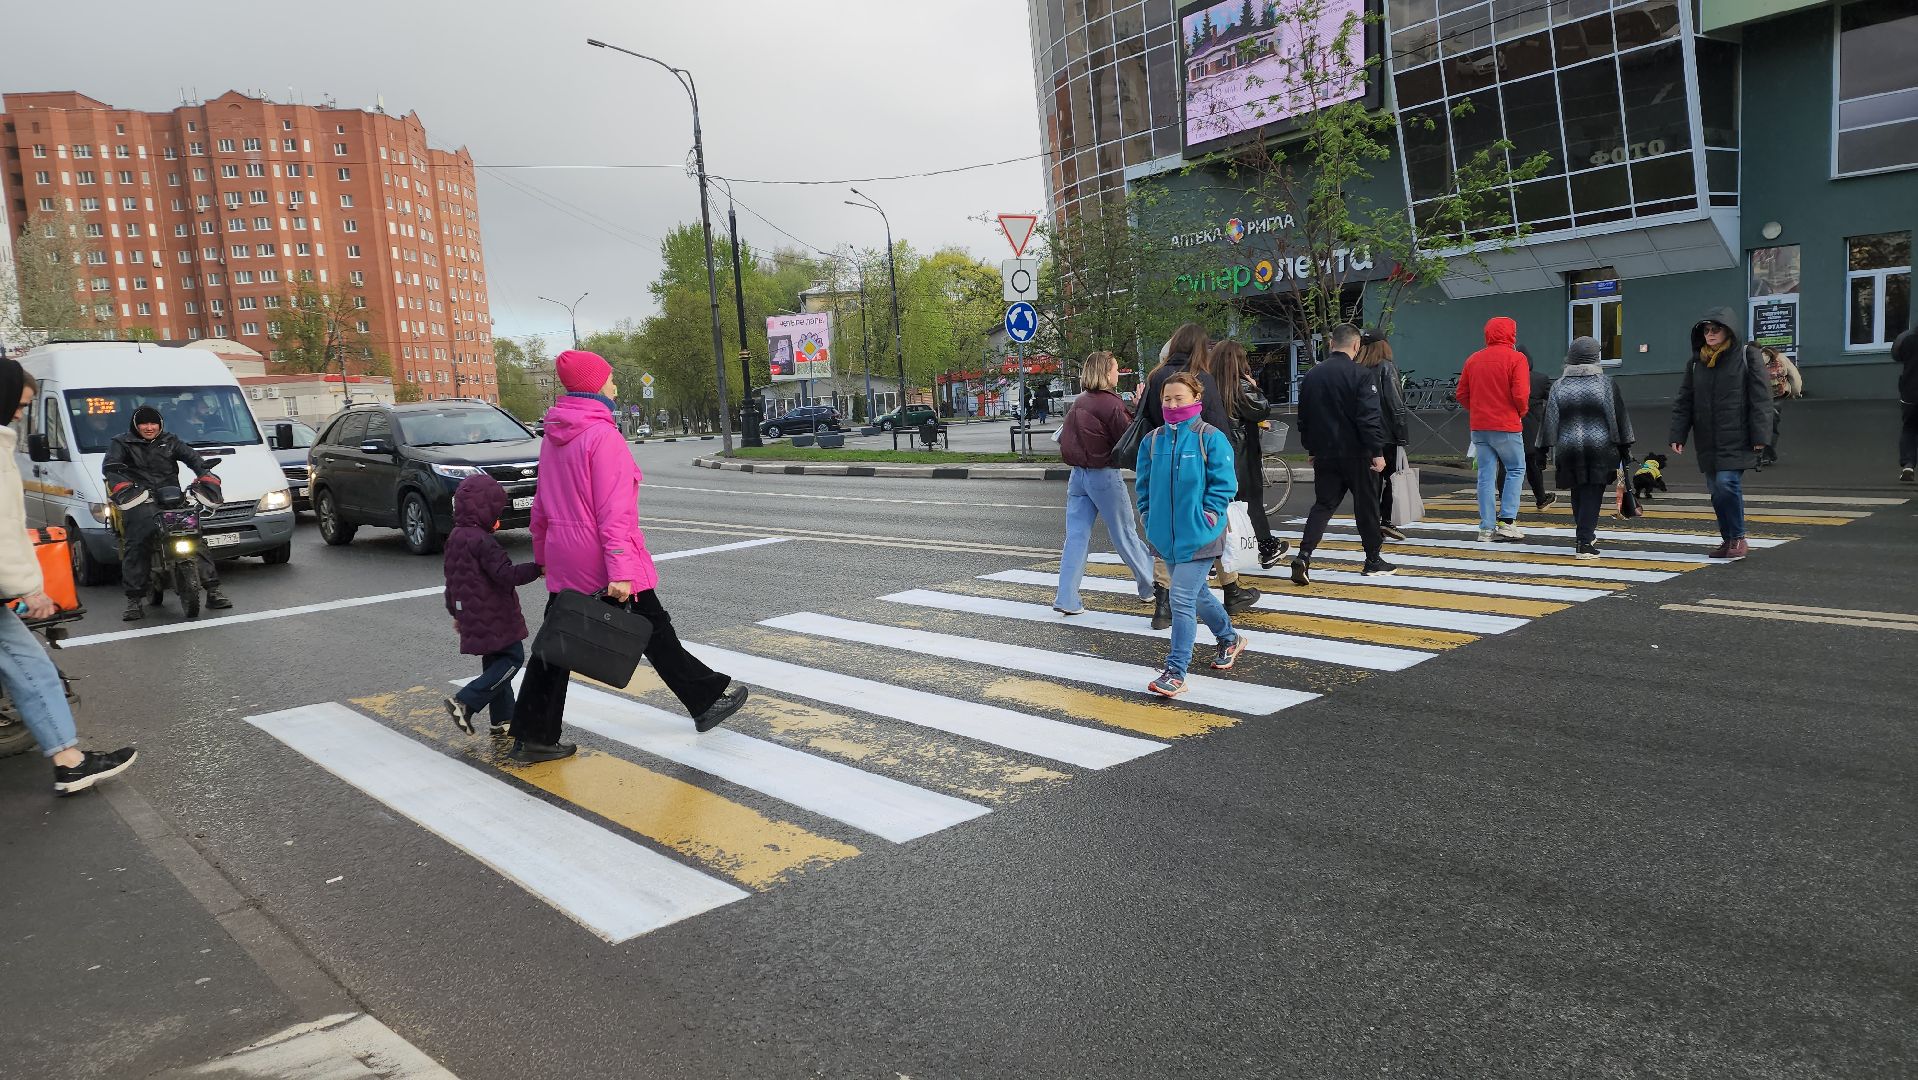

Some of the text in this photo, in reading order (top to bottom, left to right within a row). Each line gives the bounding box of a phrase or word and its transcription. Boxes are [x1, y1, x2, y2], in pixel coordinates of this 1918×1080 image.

[1589, 138, 1665, 166] ФОТО
[1171, 213, 1296, 249] АПТЕКА РИГЛА
